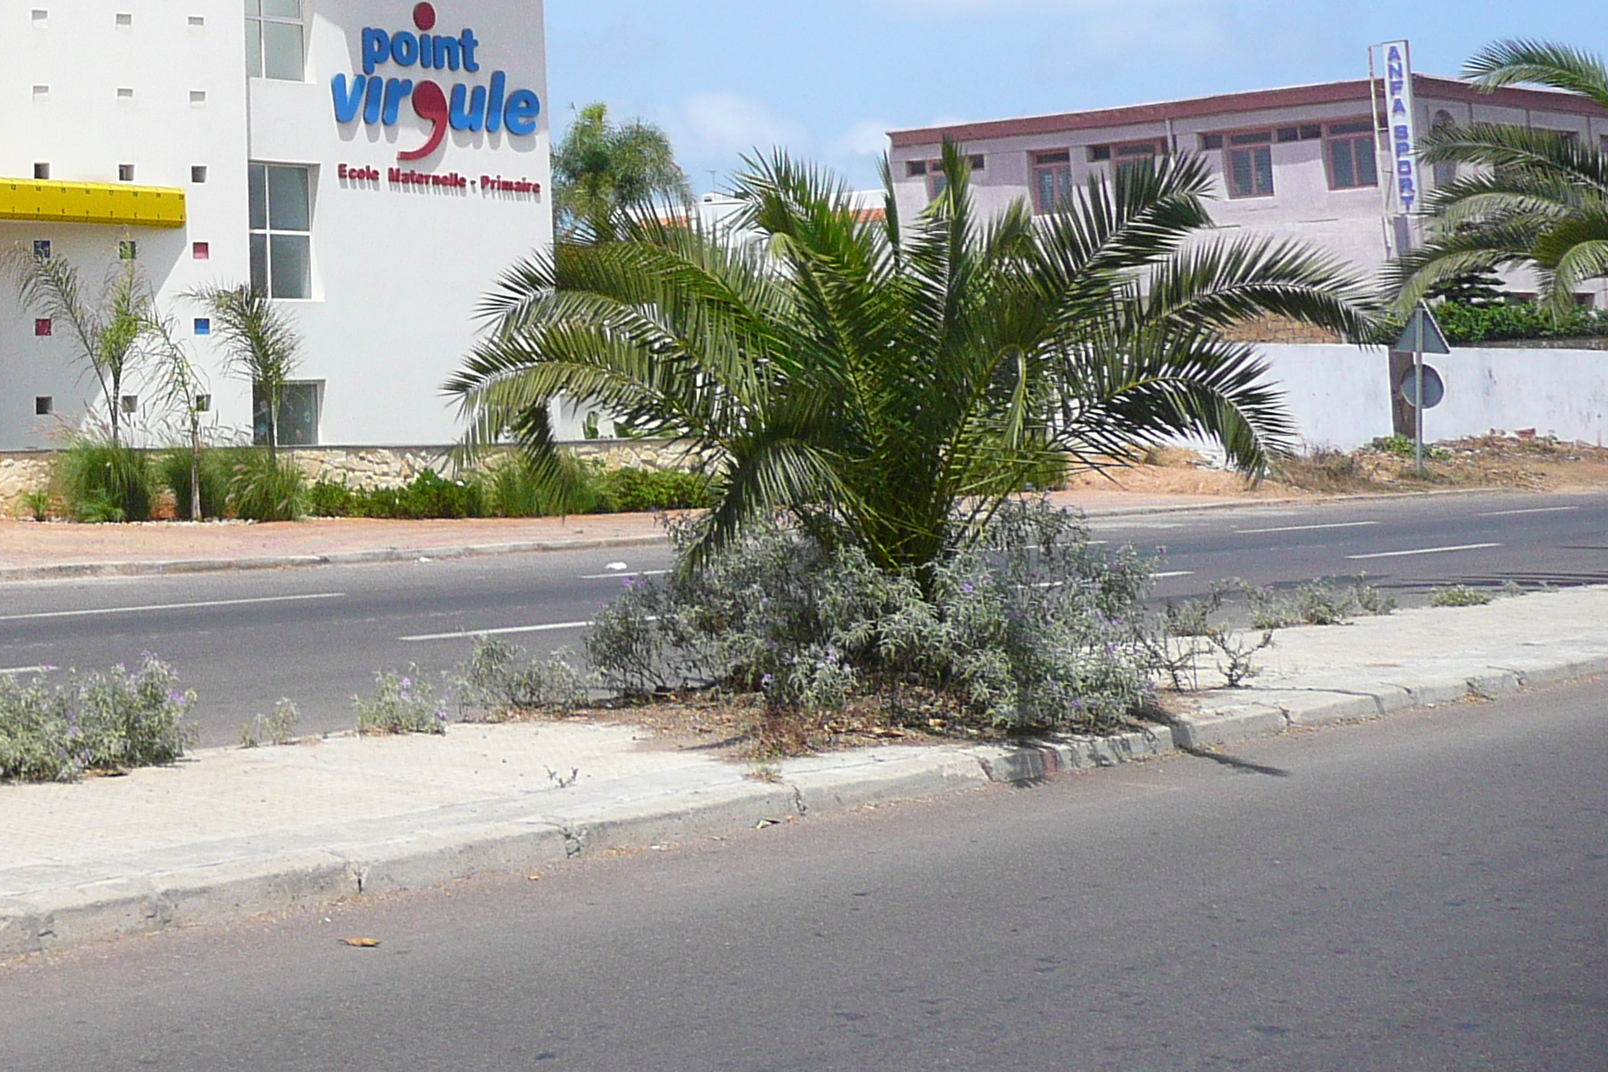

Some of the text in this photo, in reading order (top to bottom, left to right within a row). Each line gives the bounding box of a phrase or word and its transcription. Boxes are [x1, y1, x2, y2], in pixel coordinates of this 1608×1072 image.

[361, 2, 480, 75] point
[1386, 45, 1416, 212] ANFA SPORT
[337, 163, 380, 181] Ecole
[387, 166, 467, 188] Maternelle
[480, 174, 542, 194] Primaire
